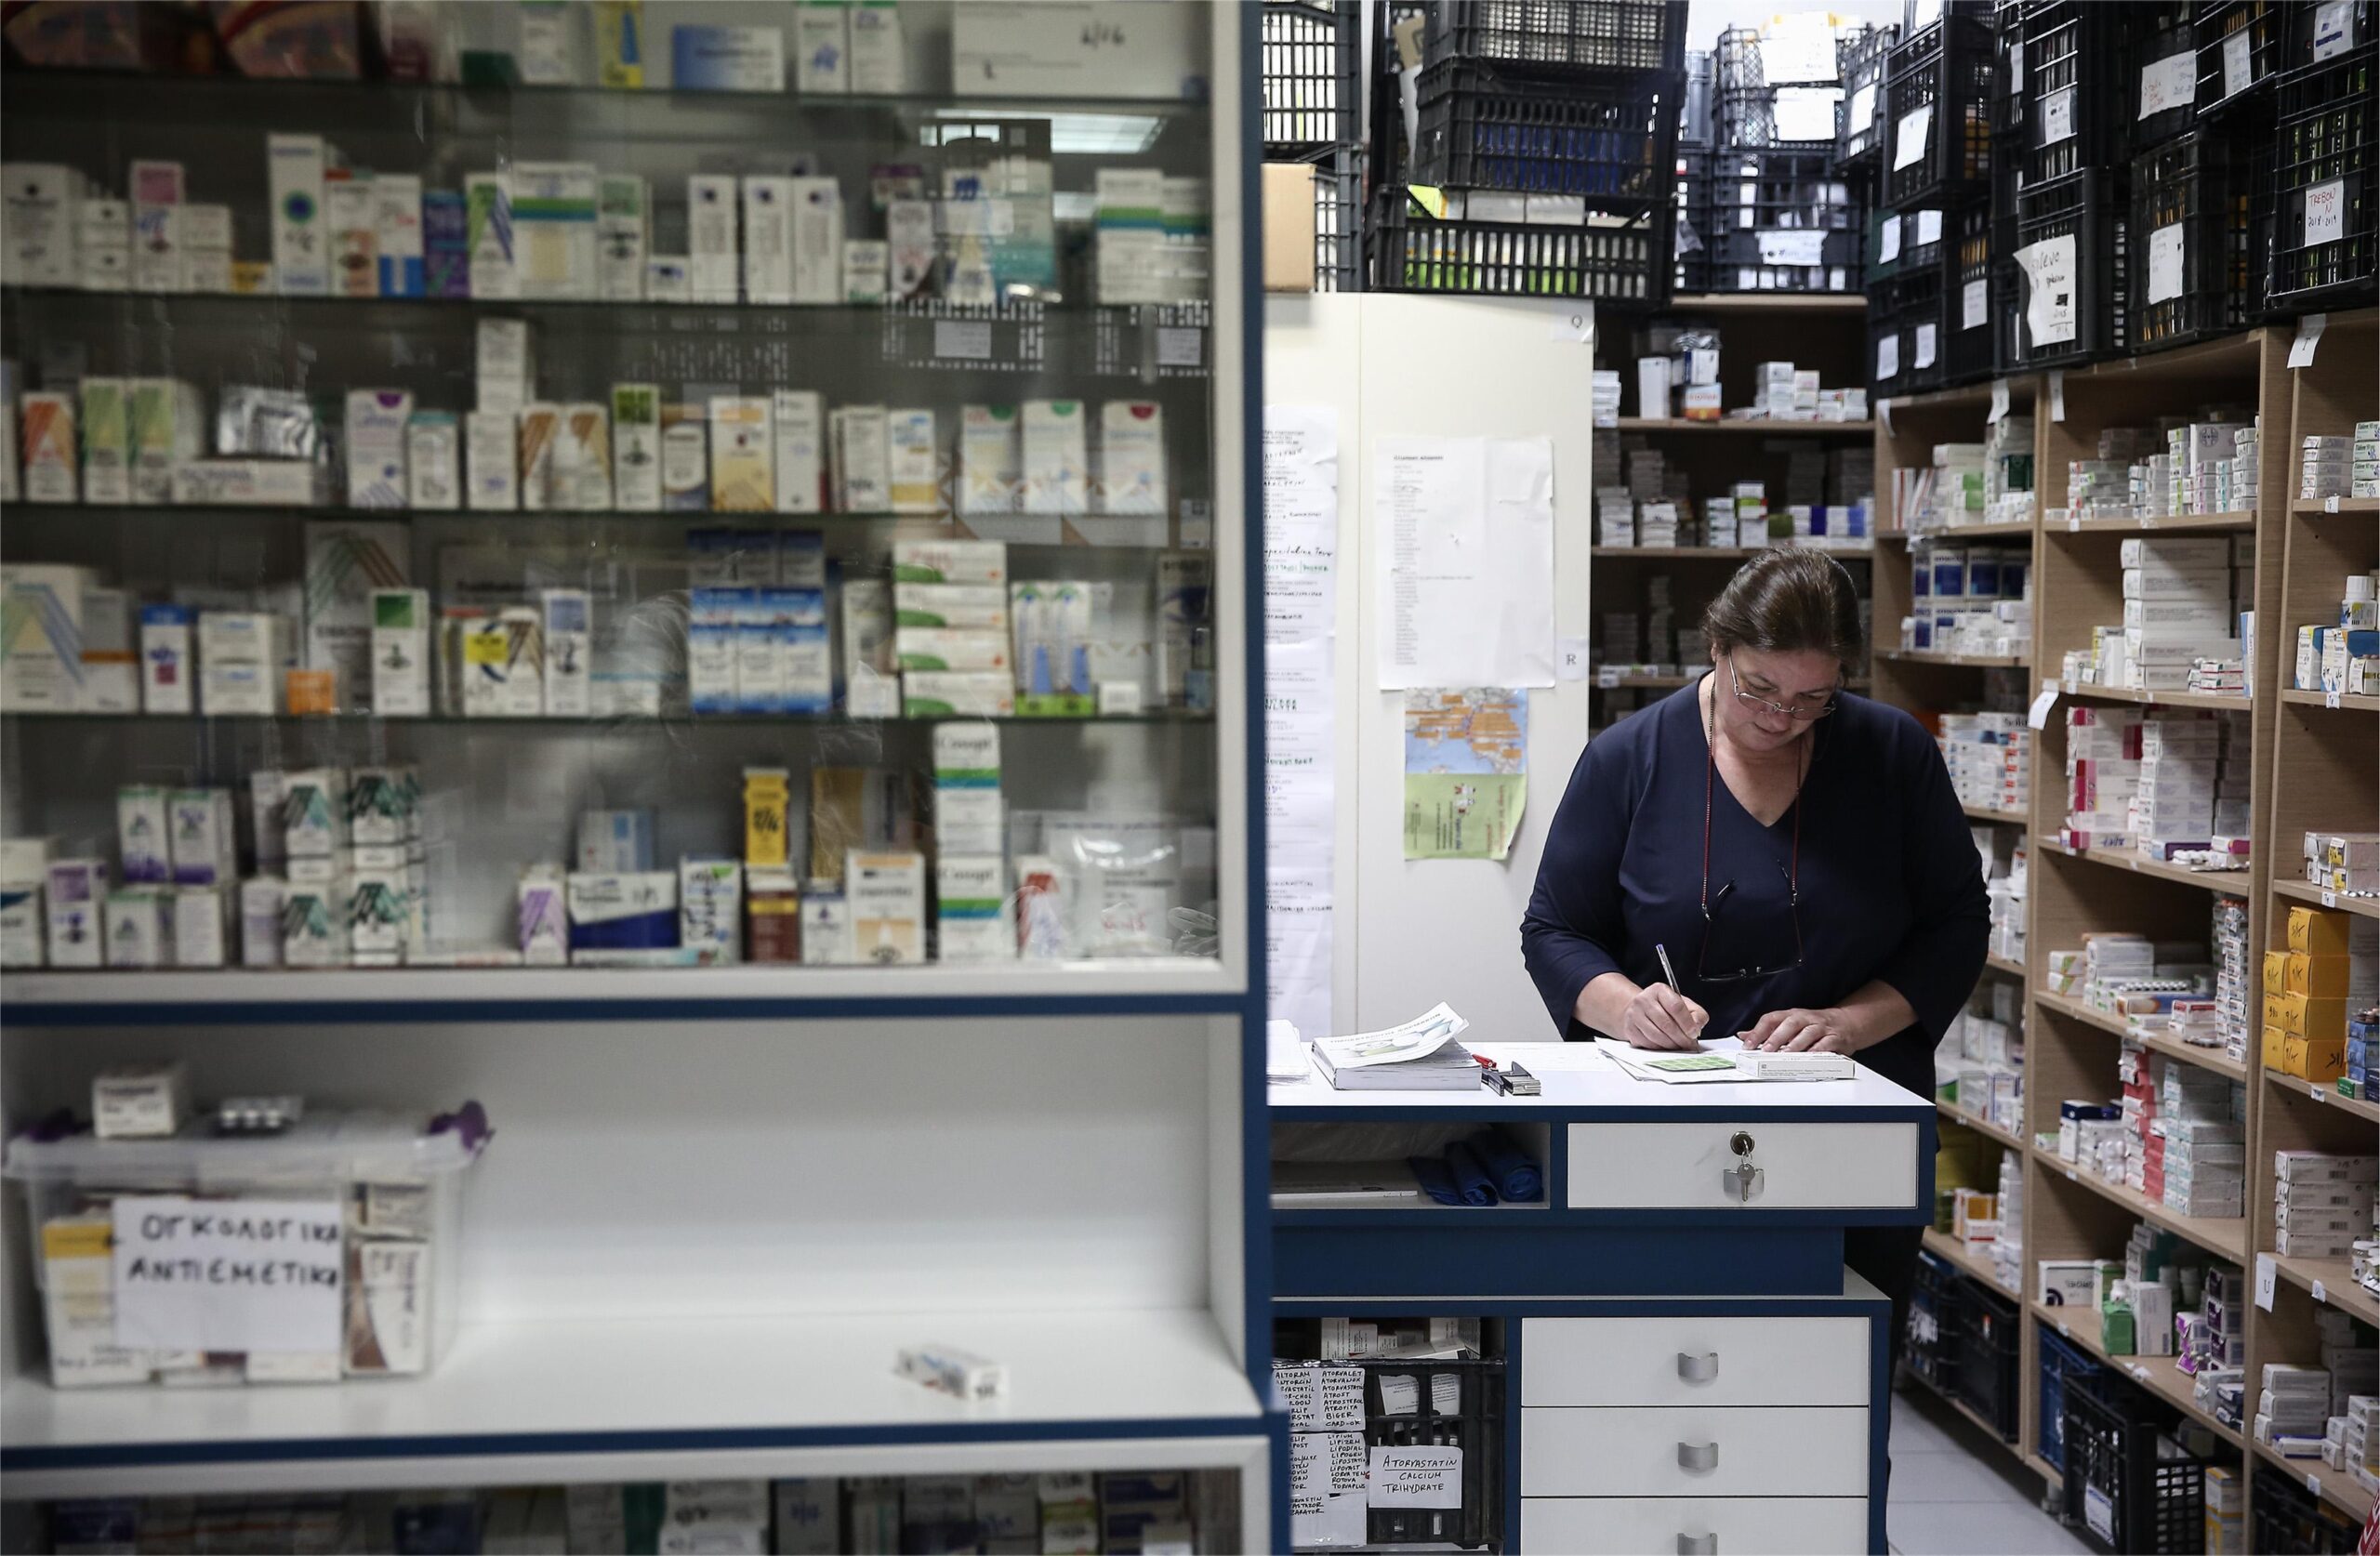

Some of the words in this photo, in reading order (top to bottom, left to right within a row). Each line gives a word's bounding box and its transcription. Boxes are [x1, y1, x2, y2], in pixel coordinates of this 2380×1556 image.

[2308, 188, 2336, 207] TREBON
[1566, 653, 1577, 666] R
[1382, 1455, 1458, 1469] ATORVASTATIN
[1399, 1471, 1442, 1481] CALCIUM
[1382, 1483, 1445, 1495] TRIHYDRATE
